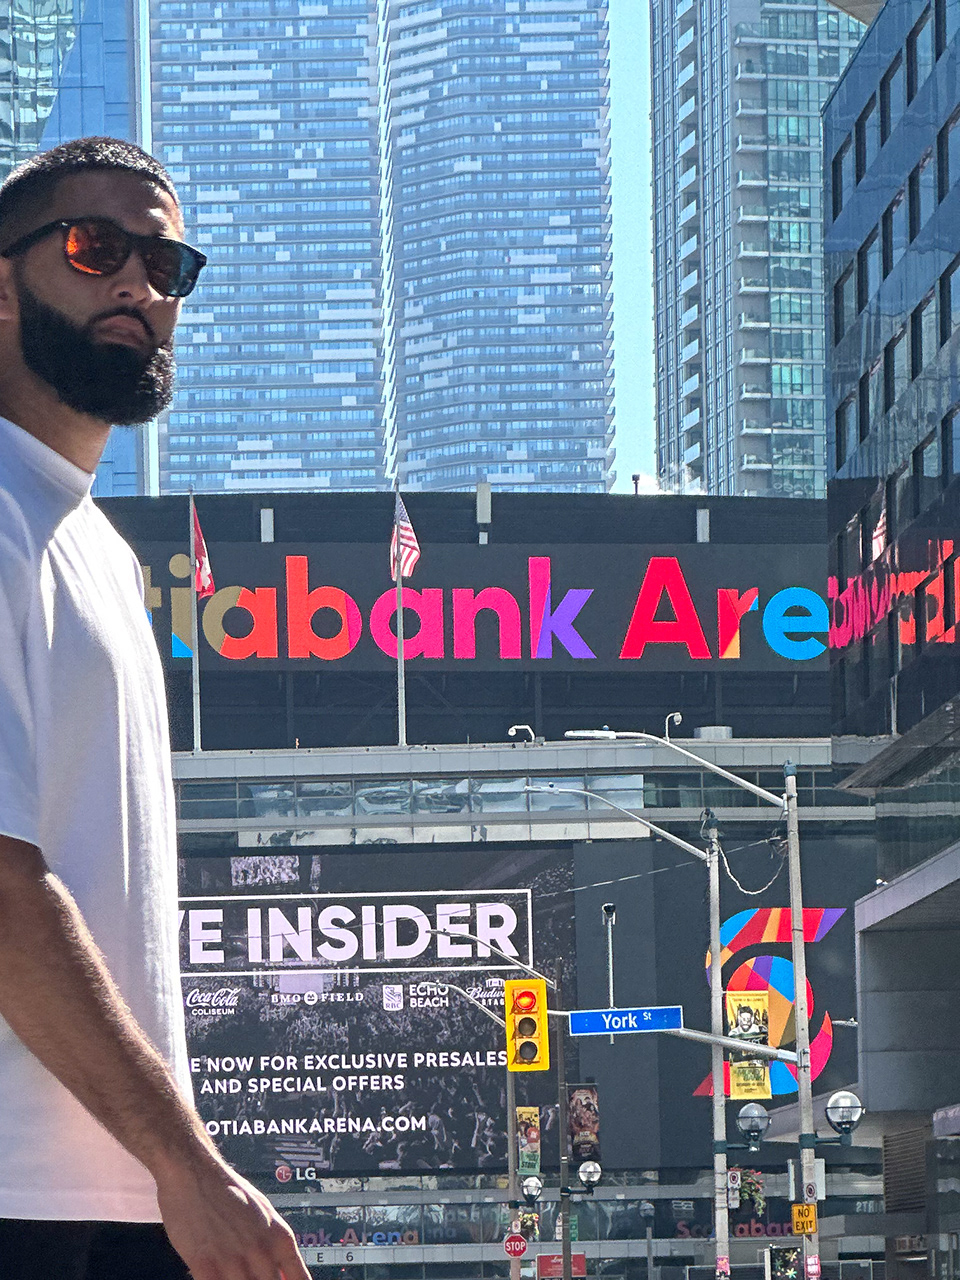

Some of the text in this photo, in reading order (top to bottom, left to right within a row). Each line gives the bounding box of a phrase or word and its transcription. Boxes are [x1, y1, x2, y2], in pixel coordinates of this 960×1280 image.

[178, 902, 520, 963] E INSIDER
[271, 992, 364, 1003] BMO FIELD
[409, 985, 449, 998] ECHO
[409, 996, 449, 1008] BEACH
[191, 1008, 235, 1016] COLISEUM
[602, 1012, 652, 1029] York St
[207, 1056, 257, 1072] NOW
[260, 1055, 298, 1071] FOR
[304, 1053, 408, 1070] EXCLUSIVE
[414, 1051, 508, 1068] PRESALES
[200, 1075, 405, 1094] AND SPECIAL OFFERS
[296, 1166, 316, 1180] LG
[797, 1208, 810, 1218] NO
[795, 1220, 814, 1231] EXIT
[343, 1228, 419, 1246] Arena
[505, 1242, 526, 1251] STOP
